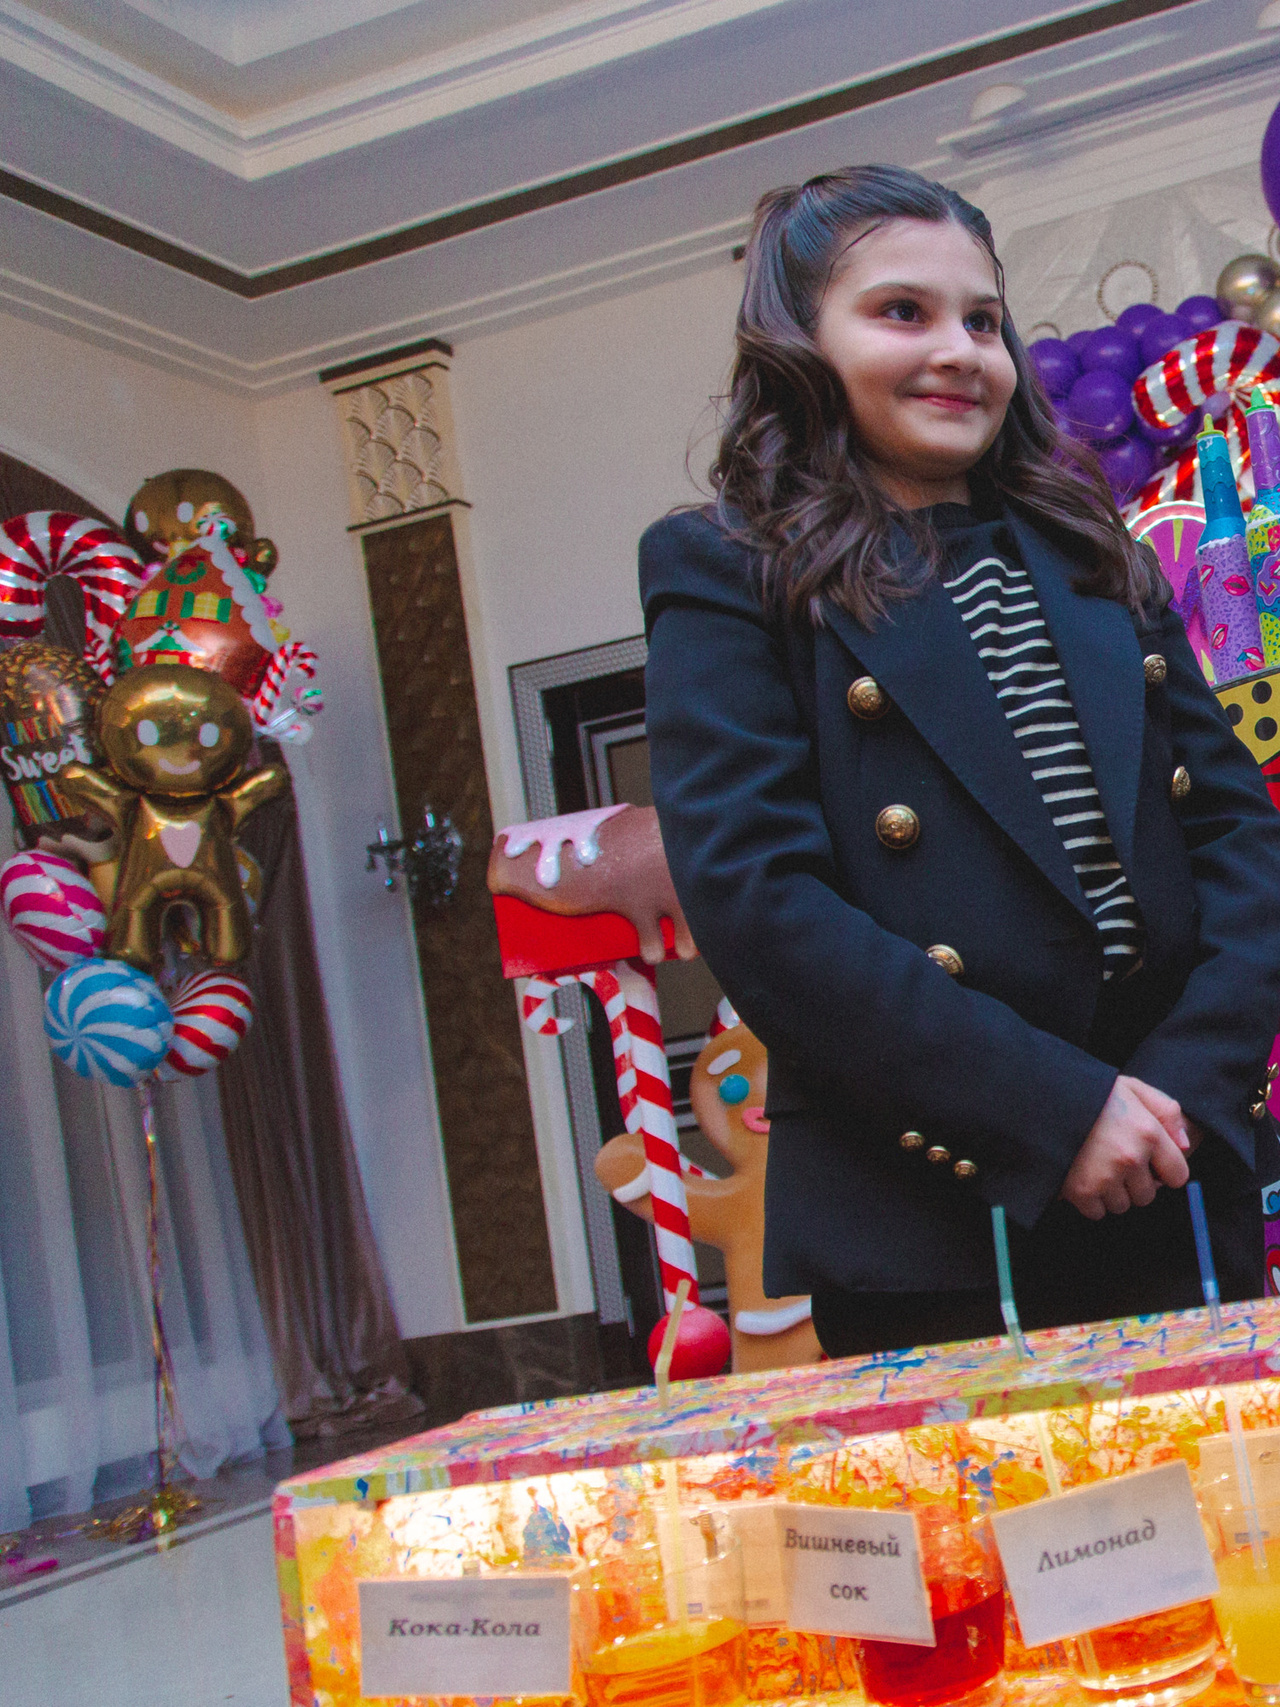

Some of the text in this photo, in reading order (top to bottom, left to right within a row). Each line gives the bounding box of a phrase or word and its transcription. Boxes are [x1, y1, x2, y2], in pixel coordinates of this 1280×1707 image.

[785, 1528, 901, 1557] Вишневый
[1037, 1518, 1157, 1574] Лимонад
[829, 1583, 869, 1601] сок
[387, 1617, 542, 1637] Кока-Кола
